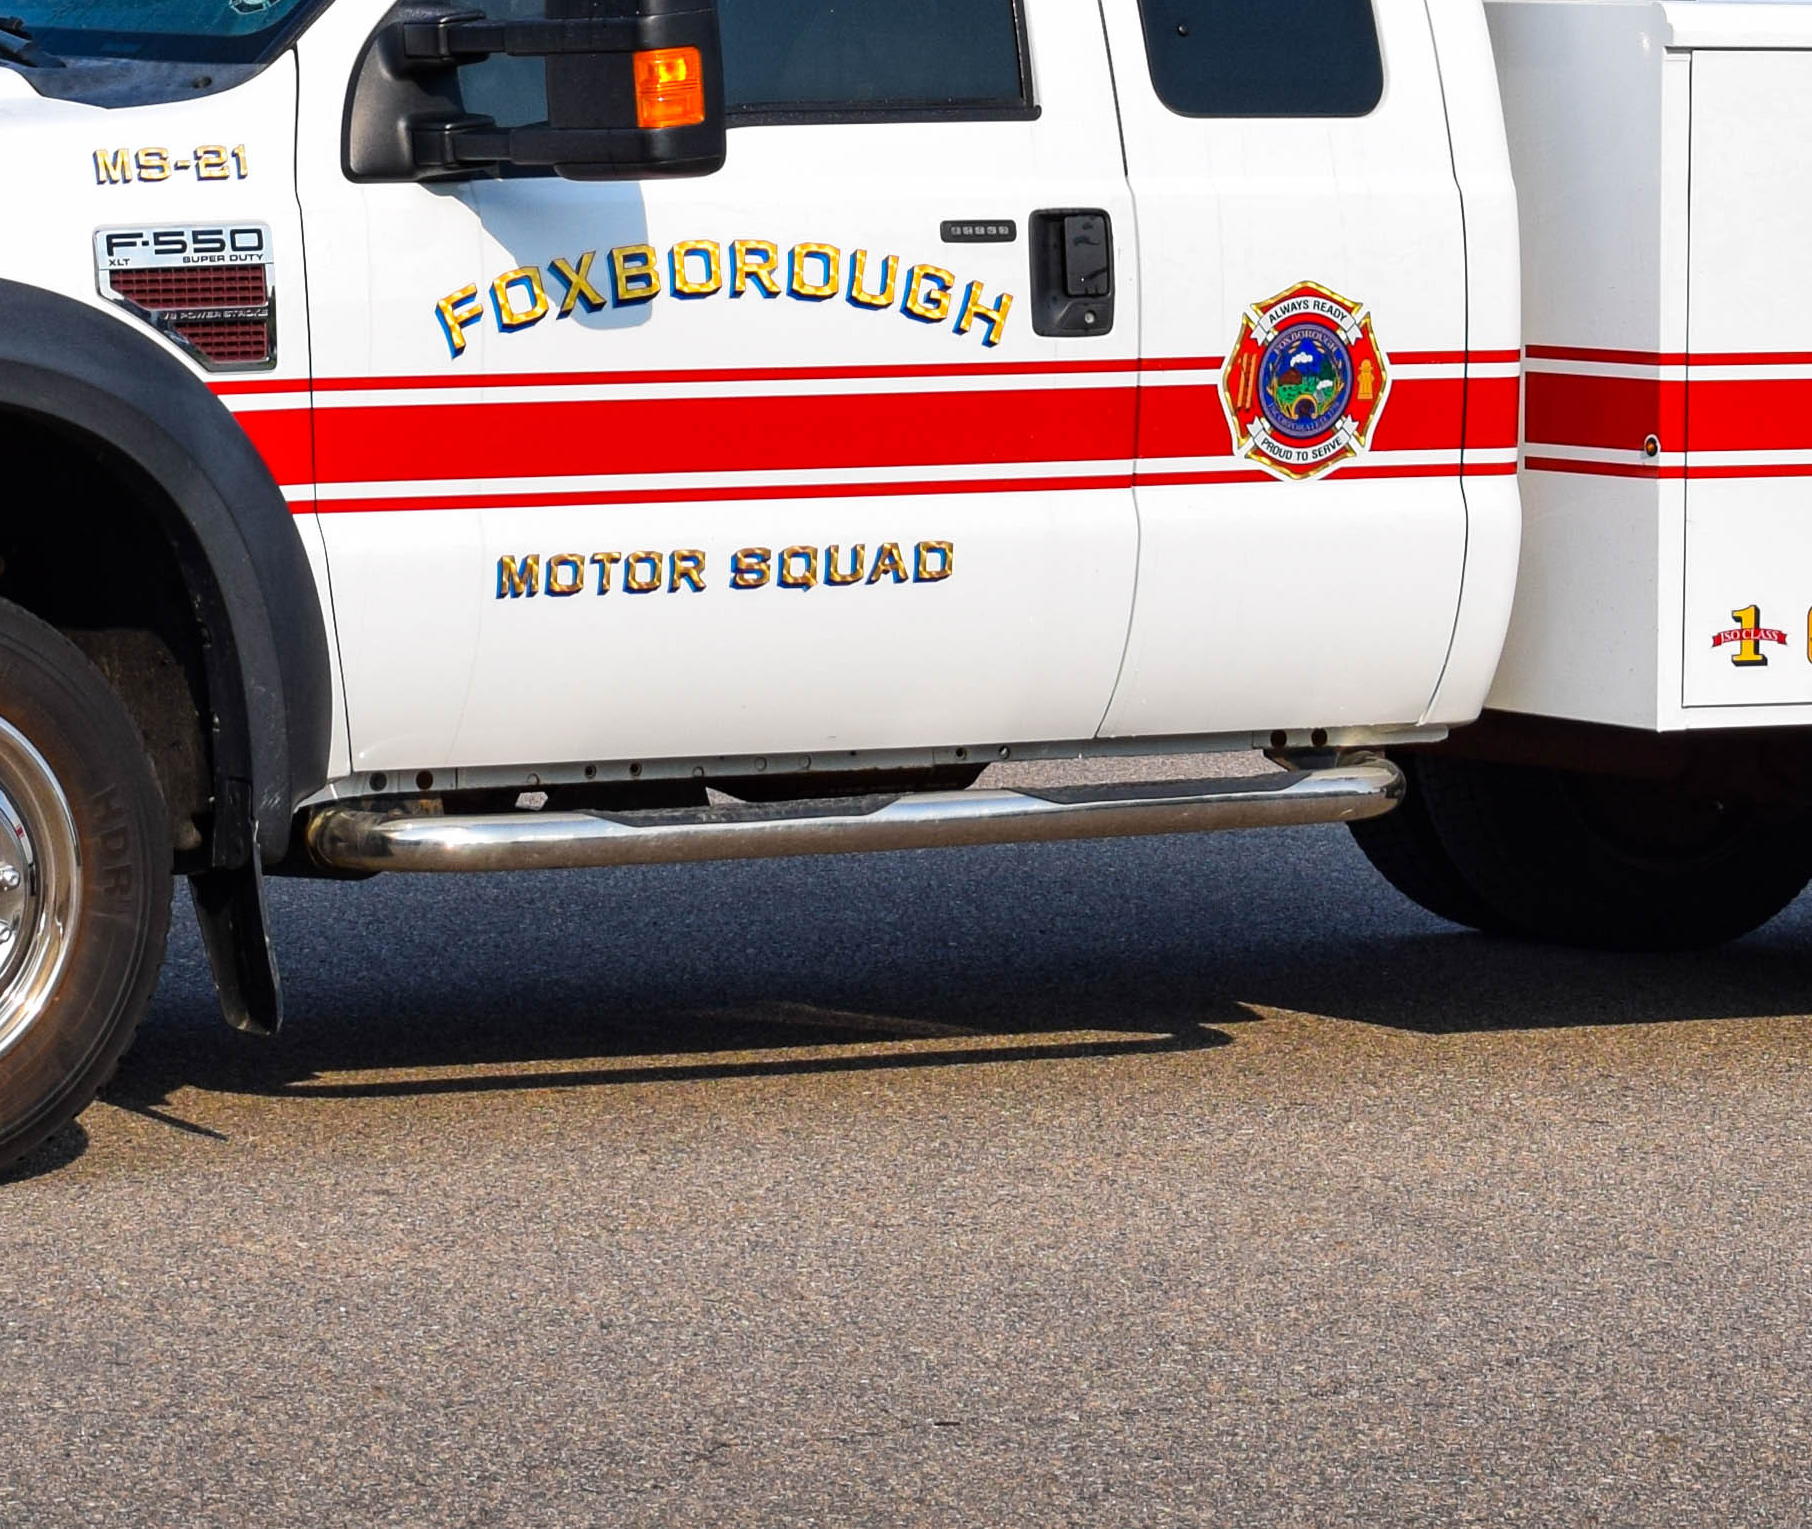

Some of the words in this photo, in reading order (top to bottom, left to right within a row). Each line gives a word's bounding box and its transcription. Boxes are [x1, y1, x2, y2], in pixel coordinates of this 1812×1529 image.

[92, 144, 248, 185] MS-21
[105, 228, 264, 257] F-550
[108, 258, 130, 267] XLT
[182, 255, 225, 264] SUPER
[229, 253, 264, 262] DUTY
[435, 239, 1014, 360] FOXBOROUGH
[1268, 299, 1310, 324] ALWAYS
[1312, 299, 1348, 322] READY
[1261, 437, 1293, 460] PROUD
[1295, 451, 1308, 462] TO
[1311, 436, 1342, 459] SERVE
[495, 548, 707, 599] MOTOR
[729, 539, 954, 593] SQUAD
[1720, 629, 1741, 643] ISO
[1741, 628, 1779, 641] CLASS
[1731, 604, 1768, 667] 1
